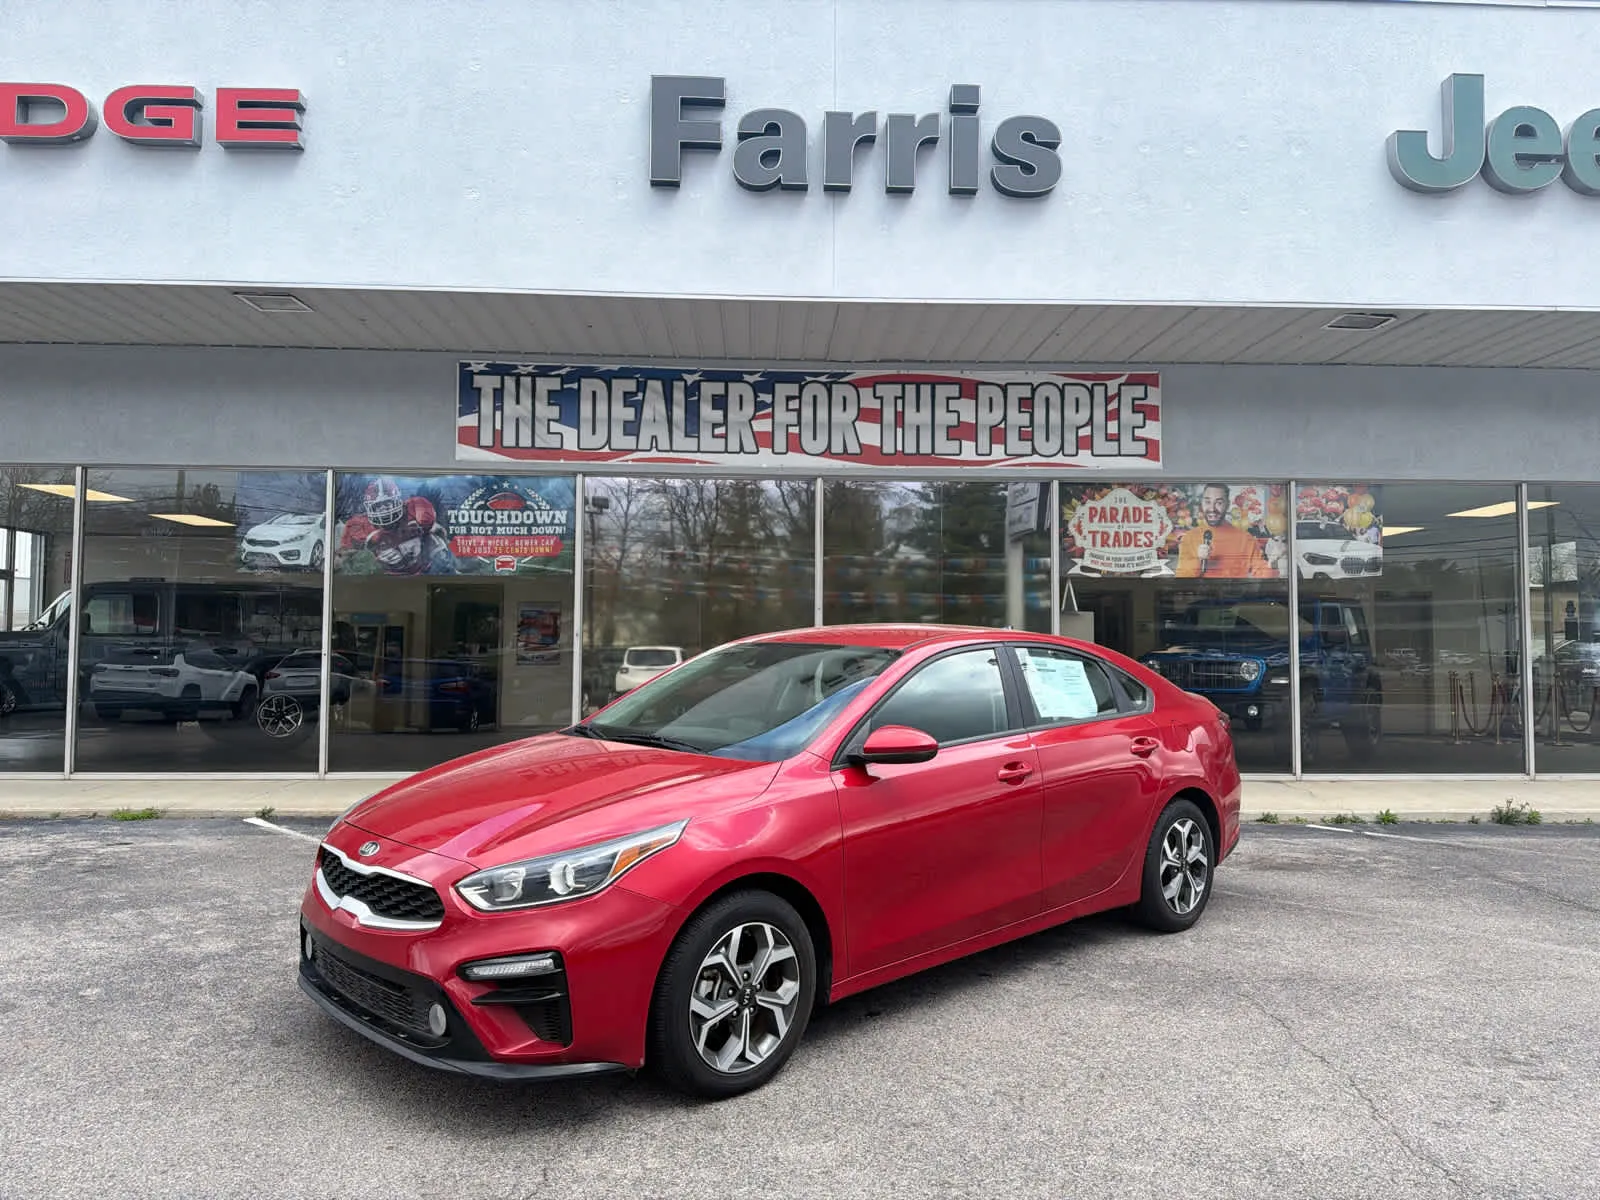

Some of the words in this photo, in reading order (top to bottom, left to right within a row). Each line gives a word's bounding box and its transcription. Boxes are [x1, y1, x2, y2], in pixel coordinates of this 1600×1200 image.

[650, 74, 1063, 197] Farris
[472, 373, 566, 451] THE
[577, 377, 760, 455] DEALER
[771, 381, 861, 456] FOR
[872, 382, 966, 458] THE
[974, 381, 1149, 459] PEOPLE
[447, 510, 568, 524] TOUCHDOWN
[1088, 506, 1153, 524] PARADE
[449, 526, 469, 535] FOR
[471, 526, 493, 535] NOT
[496, 526, 528, 535] MUCH
[1088, 530, 1153, 548] TRADES
